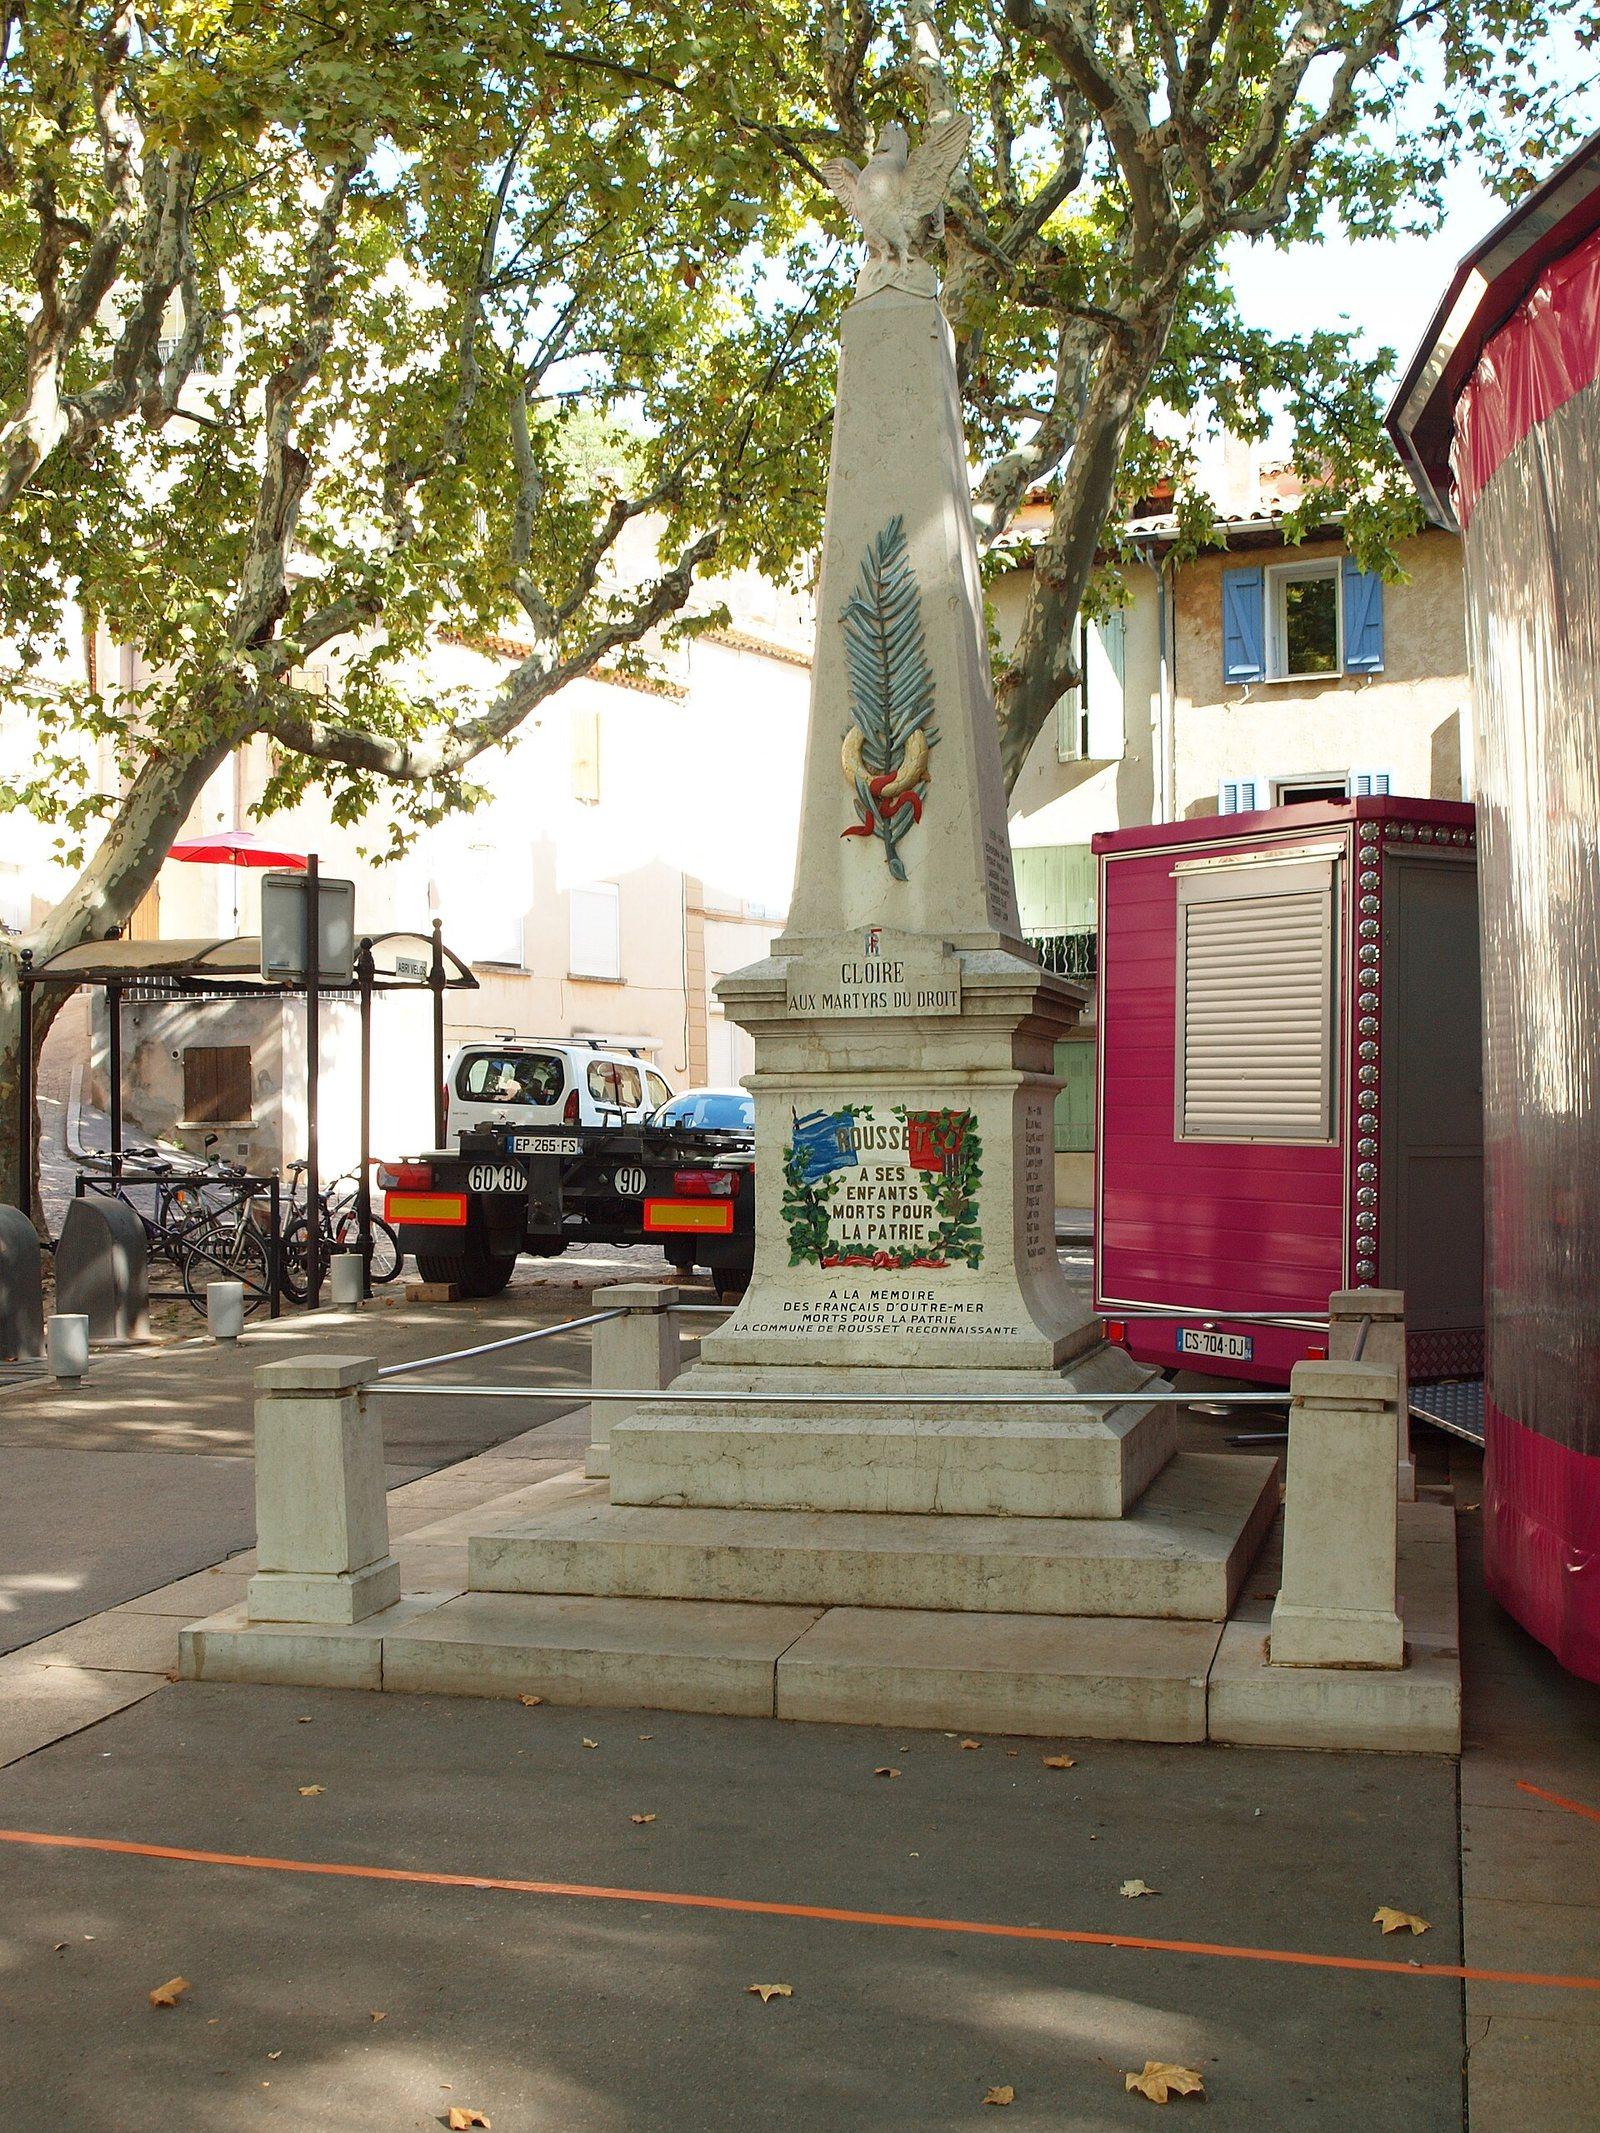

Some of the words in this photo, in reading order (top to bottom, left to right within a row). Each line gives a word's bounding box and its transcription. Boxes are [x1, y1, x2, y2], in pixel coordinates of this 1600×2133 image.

[398, 961, 410, 974] ABRI
[841, 962, 904, 984] GLOIRE
[788, 994, 816, 1011] AUX
[822, 992, 887, 1009] MARTYRS
[894, 992, 911, 1008] DU
[917, 990, 958, 1007] DROIT
[515, 1138, 576, 1153] EP-265-FS
[836, 1126, 926, 1152] ROUSSET
[473, 1166, 494, 1190] 60
[503, 1166, 523, 1190] 80
[620, 1168, 641, 1193] 90
[860, 1167, 869, 1181] A
[875, 1167, 905, 1181] SES
[847, 1186, 918, 1200] ENFANTS
[832, 1205, 885, 1219] MORTS
[892, 1205, 932, 1219] POUR
[842, 1224, 861, 1240] LA
[868, 1224, 924, 1240] PATRIE
[829, 1290, 838, 1299] A
[843, 1290, 859, 1299] LA
[870, 1290, 935, 1300] MEMOIRE
[783, 1302, 809, 1311] DES
[814, 1302, 880, 1313] FRANÇAIS
[886, 1303, 984, 1312] D'OUTRE-MER
[802, 1314, 848, 1322] MORTS
[852, 1314, 884, 1323] POUR
[891, 1315, 906, 1323] LA
[911, 1315, 957, 1324] PATRIE
[734, 1324, 748, 1332] LA
[752, 1324, 813, 1332] COMMUNE
[817, 1325, 833, 1333] DE
[838, 1324, 900, 1333] ROUSSET
[906, 1325, 1018, 1335] RECONNAISSANTE
[1185, 1332, 1244, 1357] CS-704-DJ
